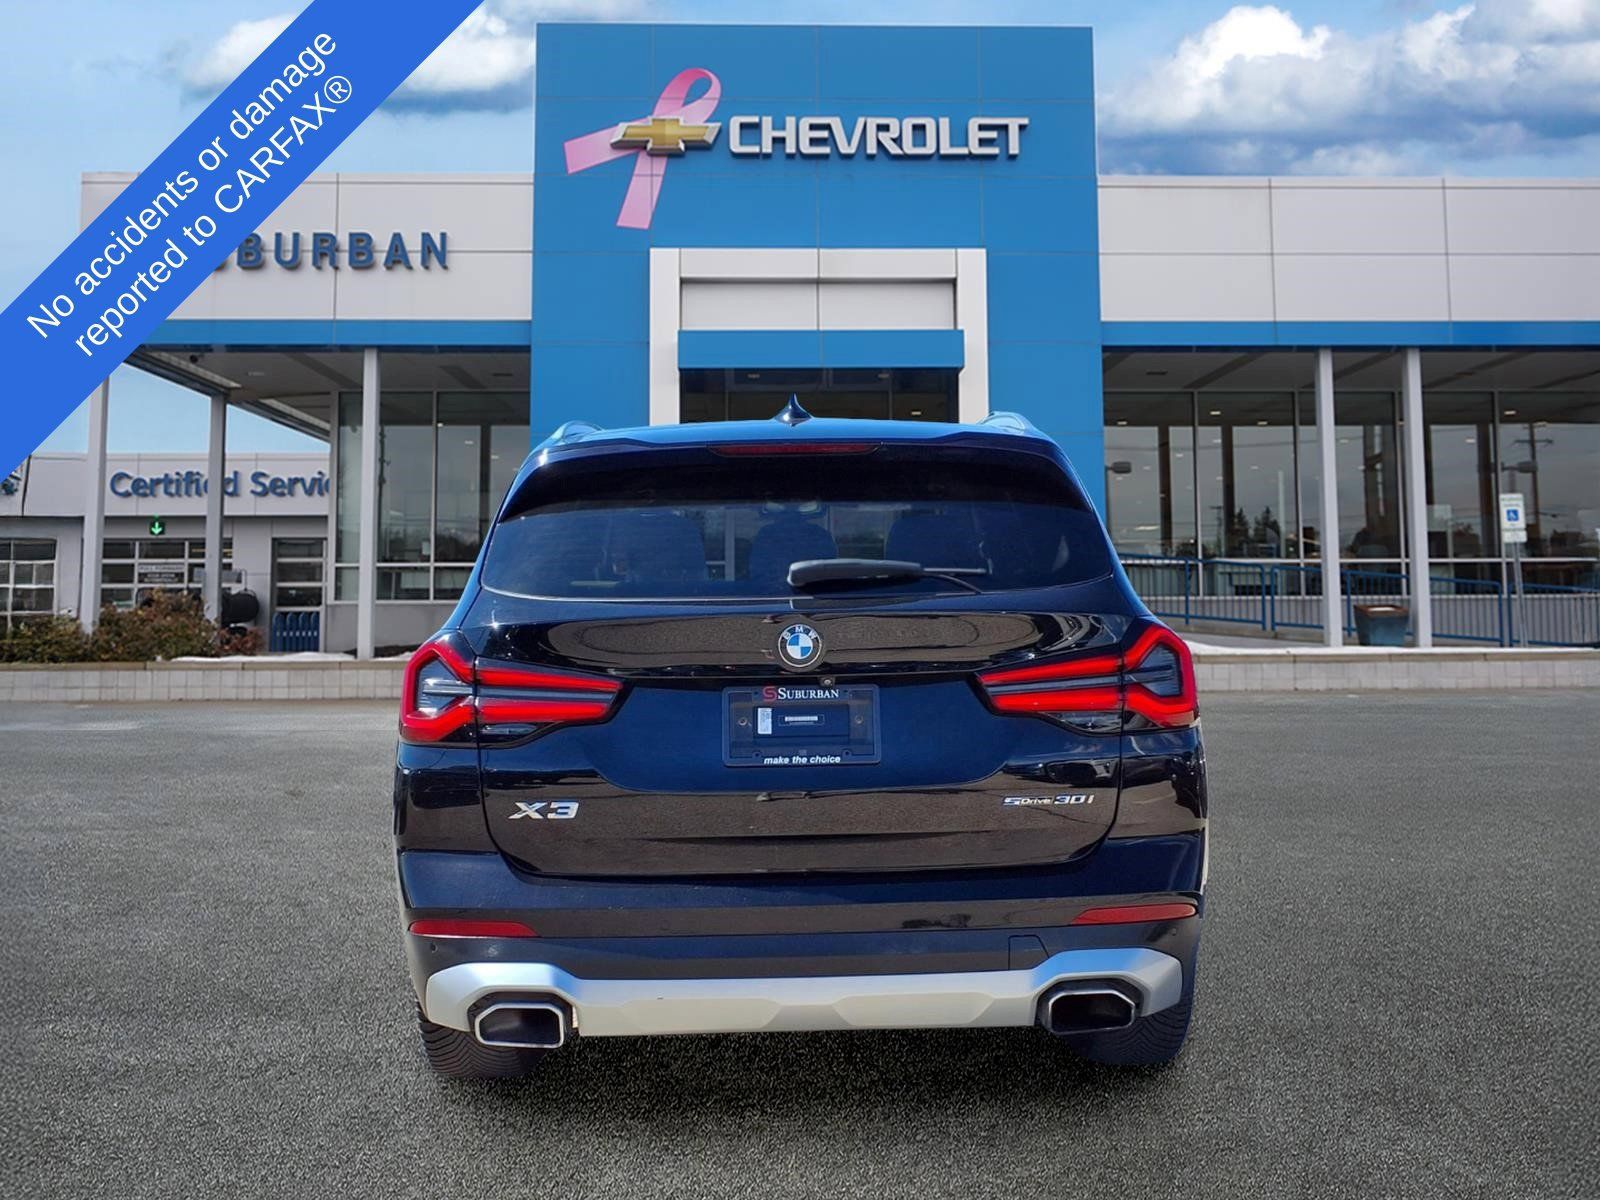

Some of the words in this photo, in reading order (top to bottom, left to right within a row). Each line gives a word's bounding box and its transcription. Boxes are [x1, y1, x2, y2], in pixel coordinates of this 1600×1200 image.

[728, 115, 1030, 157] CHEVROLET
[216, 231, 449, 271] BURBAN
[109, 470, 240, 498] Certifid
[763, 755, 790, 765] make
[791, 755, 808, 765] the
[809, 755, 841, 764] choice
[507, 801, 580, 820] X3
